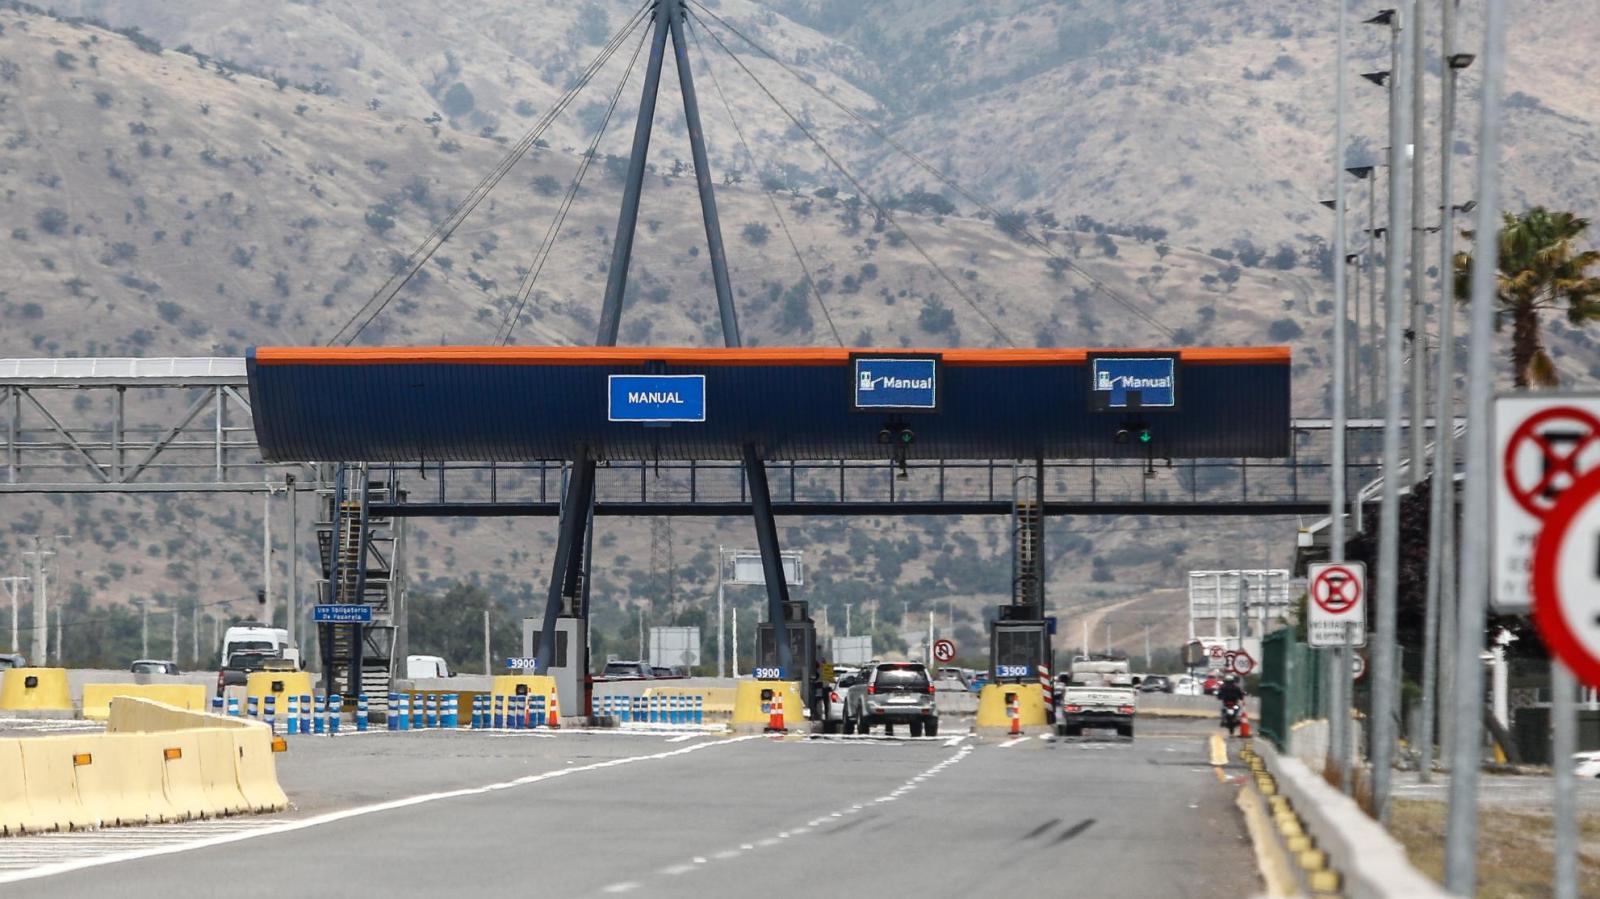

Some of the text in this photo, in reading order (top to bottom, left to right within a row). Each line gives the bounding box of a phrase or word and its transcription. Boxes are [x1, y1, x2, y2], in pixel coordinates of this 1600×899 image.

[883, 376, 932, 389] Manual
[1121, 375, 1171, 388] Manual
[628, 392, 684, 404] MANUAL
[511, 659, 535, 668] 3900
[756, 668, 780, 678] 3900
[1002, 666, 1027, 676] 3900
